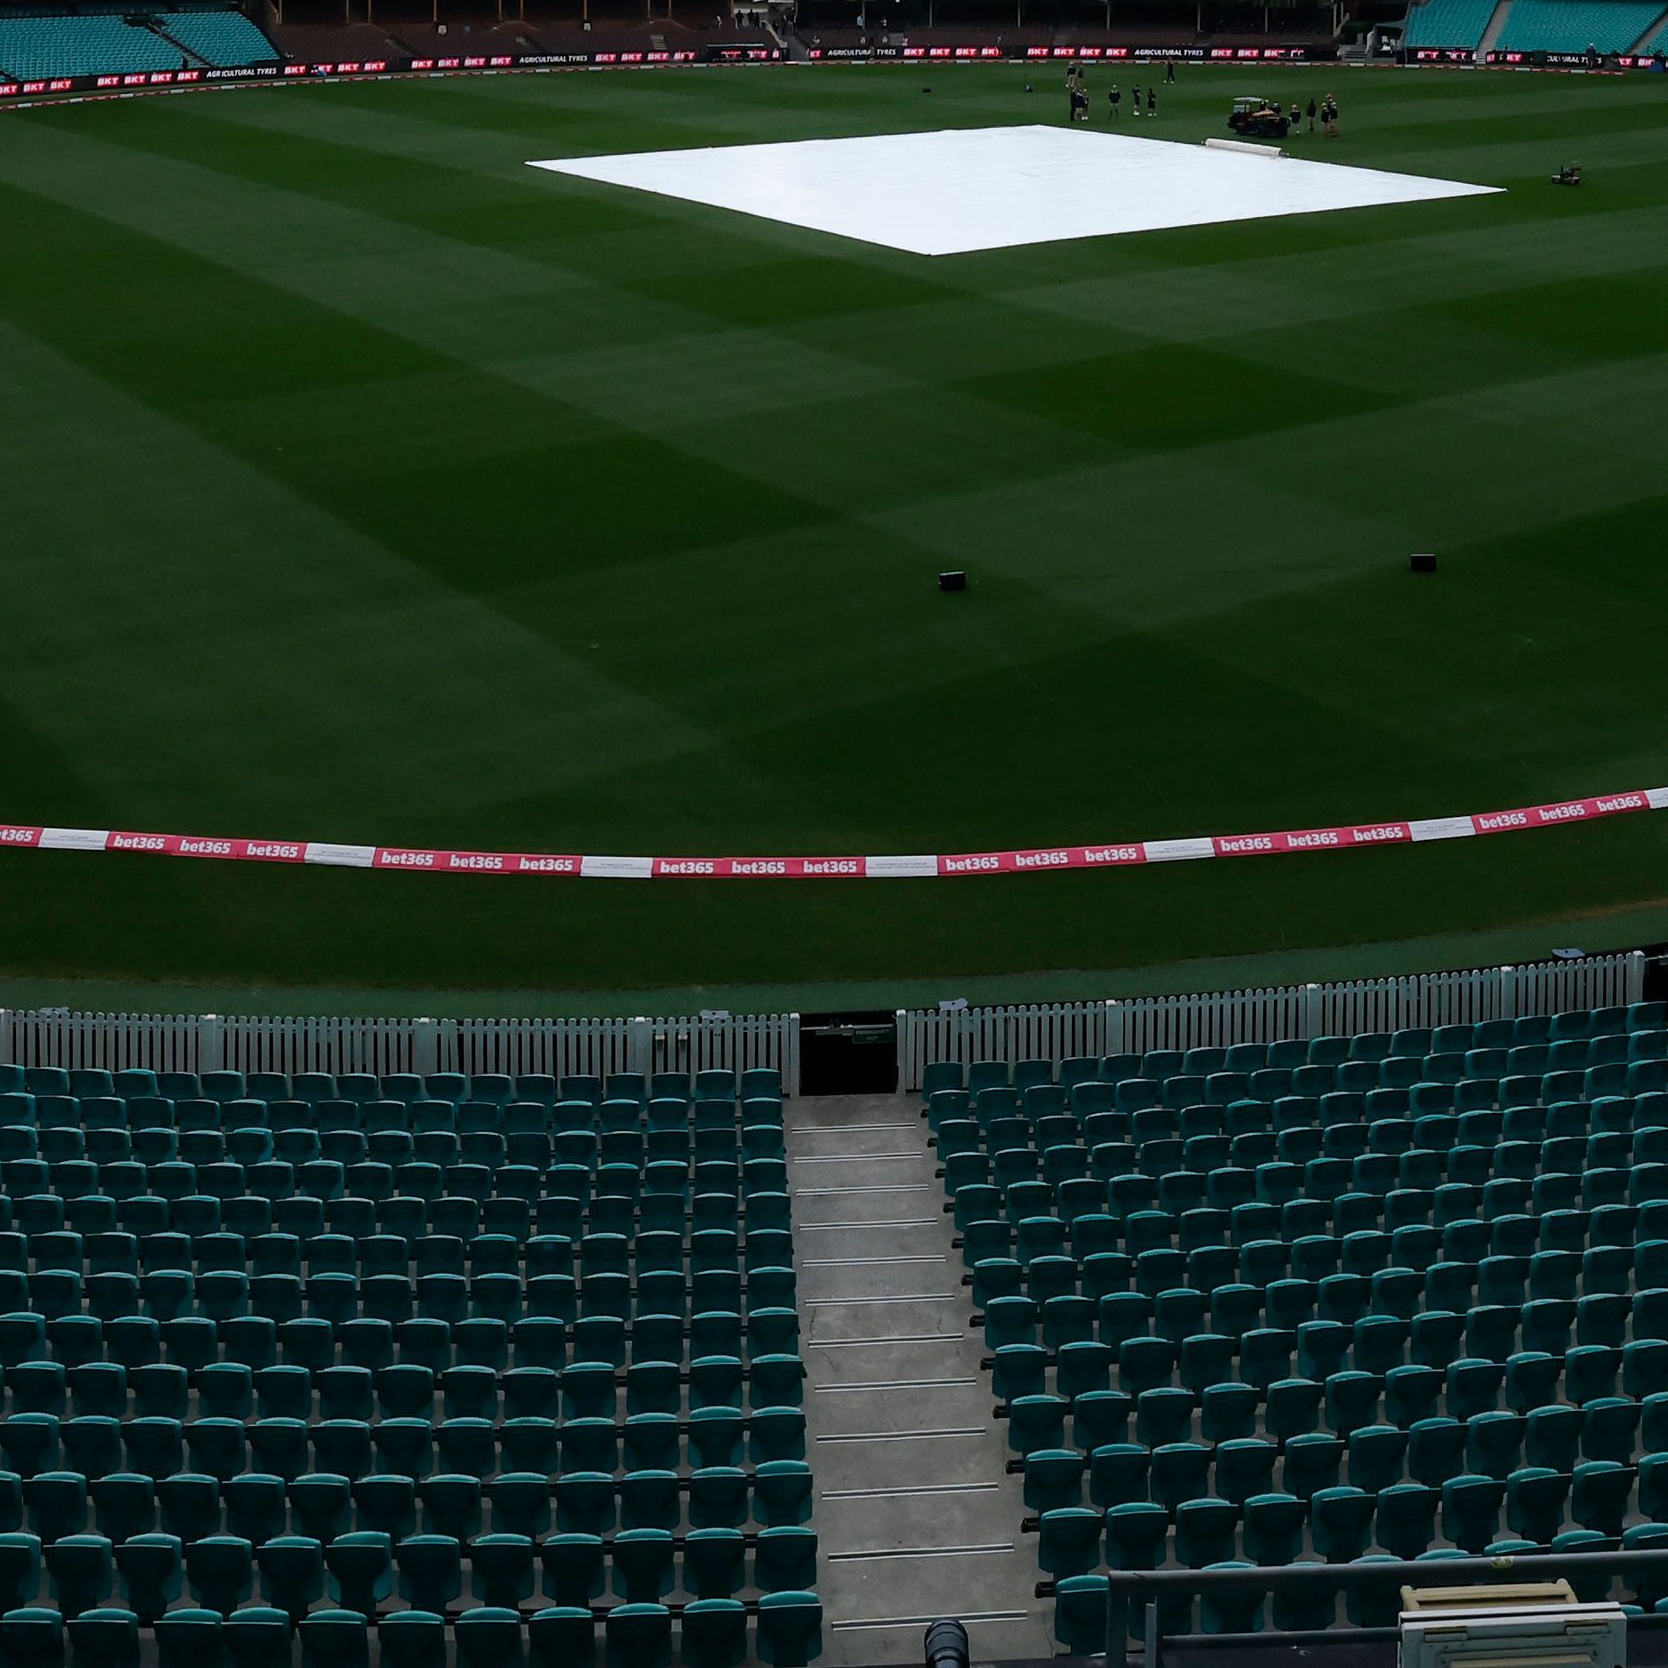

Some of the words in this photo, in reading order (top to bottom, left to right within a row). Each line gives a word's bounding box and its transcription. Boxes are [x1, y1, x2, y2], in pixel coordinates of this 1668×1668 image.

[519, 55, 566, 64] AGRICULTURAL
[567, 53, 588, 62] TYRES
[904, 47, 925, 57] BKT
[1135, 49, 1182, 57] AGRICULTURAL
[1183, 49, 1204, 57] TYRES
[177, 71, 199, 80] BKT
[207, 68, 255, 78] AGRICULTURAL
[256, 67, 276, 75] TYRES
[97, 76, 119, 86] BKT
[1596, 794, 1643, 812] bet365
[1539, 803, 1585, 820] bet365
[1479, 813, 1527, 829] bet365
[113, 834, 165, 850] bet365
[1220, 837, 1273, 852] bet365
[1287, 832, 1339, 847] bet365
[246, 843, 299, 858] bet365
[381, 850, 434, 866] bet365
[1084, 848, 1137, 863] bet365
[449, 854, 503, 869] bet365
[660, 859, 714, 874] bet365
[732, 860, 785, 874] bet365
[803, 859, 857, 874] bet365
[945, 856, 1000, 871] bet365
